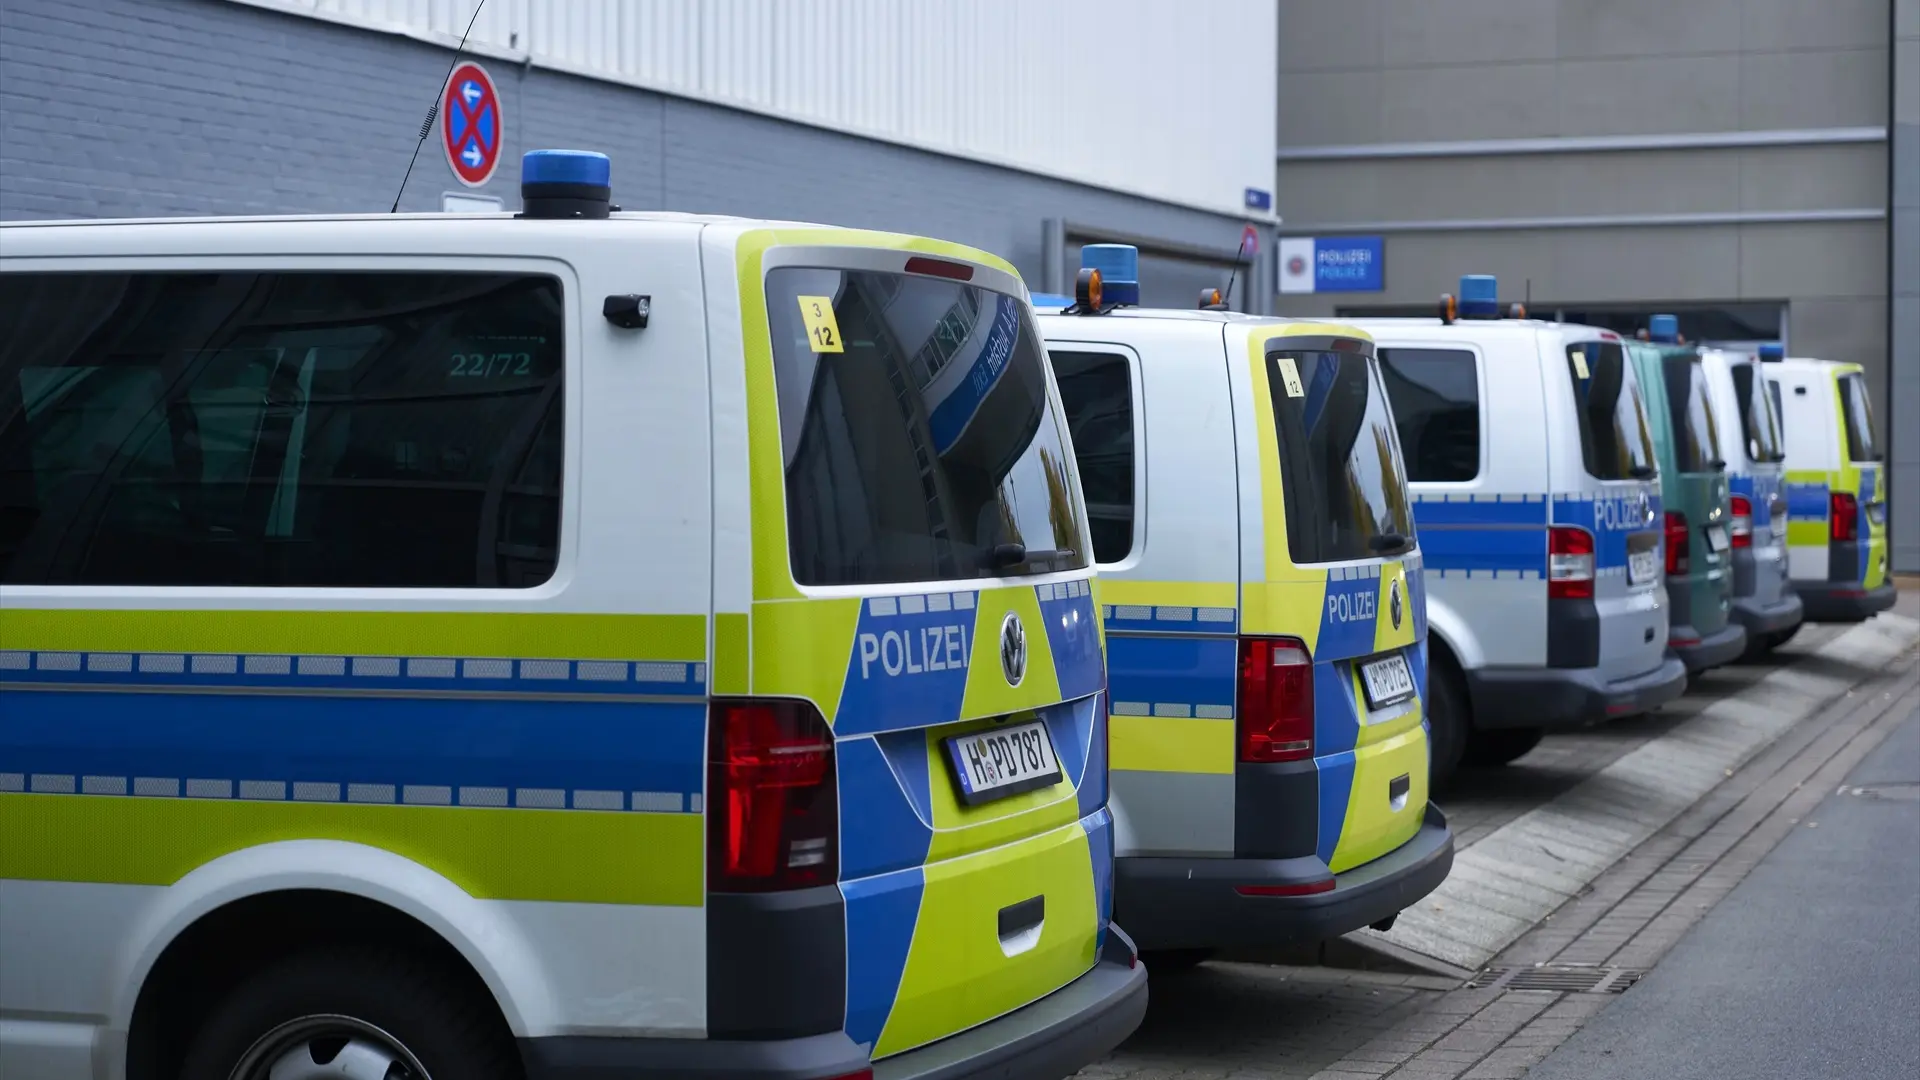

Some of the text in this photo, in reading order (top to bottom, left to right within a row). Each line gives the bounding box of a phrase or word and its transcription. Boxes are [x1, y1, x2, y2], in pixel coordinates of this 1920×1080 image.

[1317, 249, 1371, 266] POLIZEI
[812, 302, 822, 318] 3
[814, 326, 834, 346] 12
[450, 352, 531, 378] 22/72
[1289, 380, 1300, 394] 12
[1593, 500, 1643, 532] POLIZE
[1327, 590, 1377, 624] POLIZEI
[859, 624, 968, 679] POLIZEI
